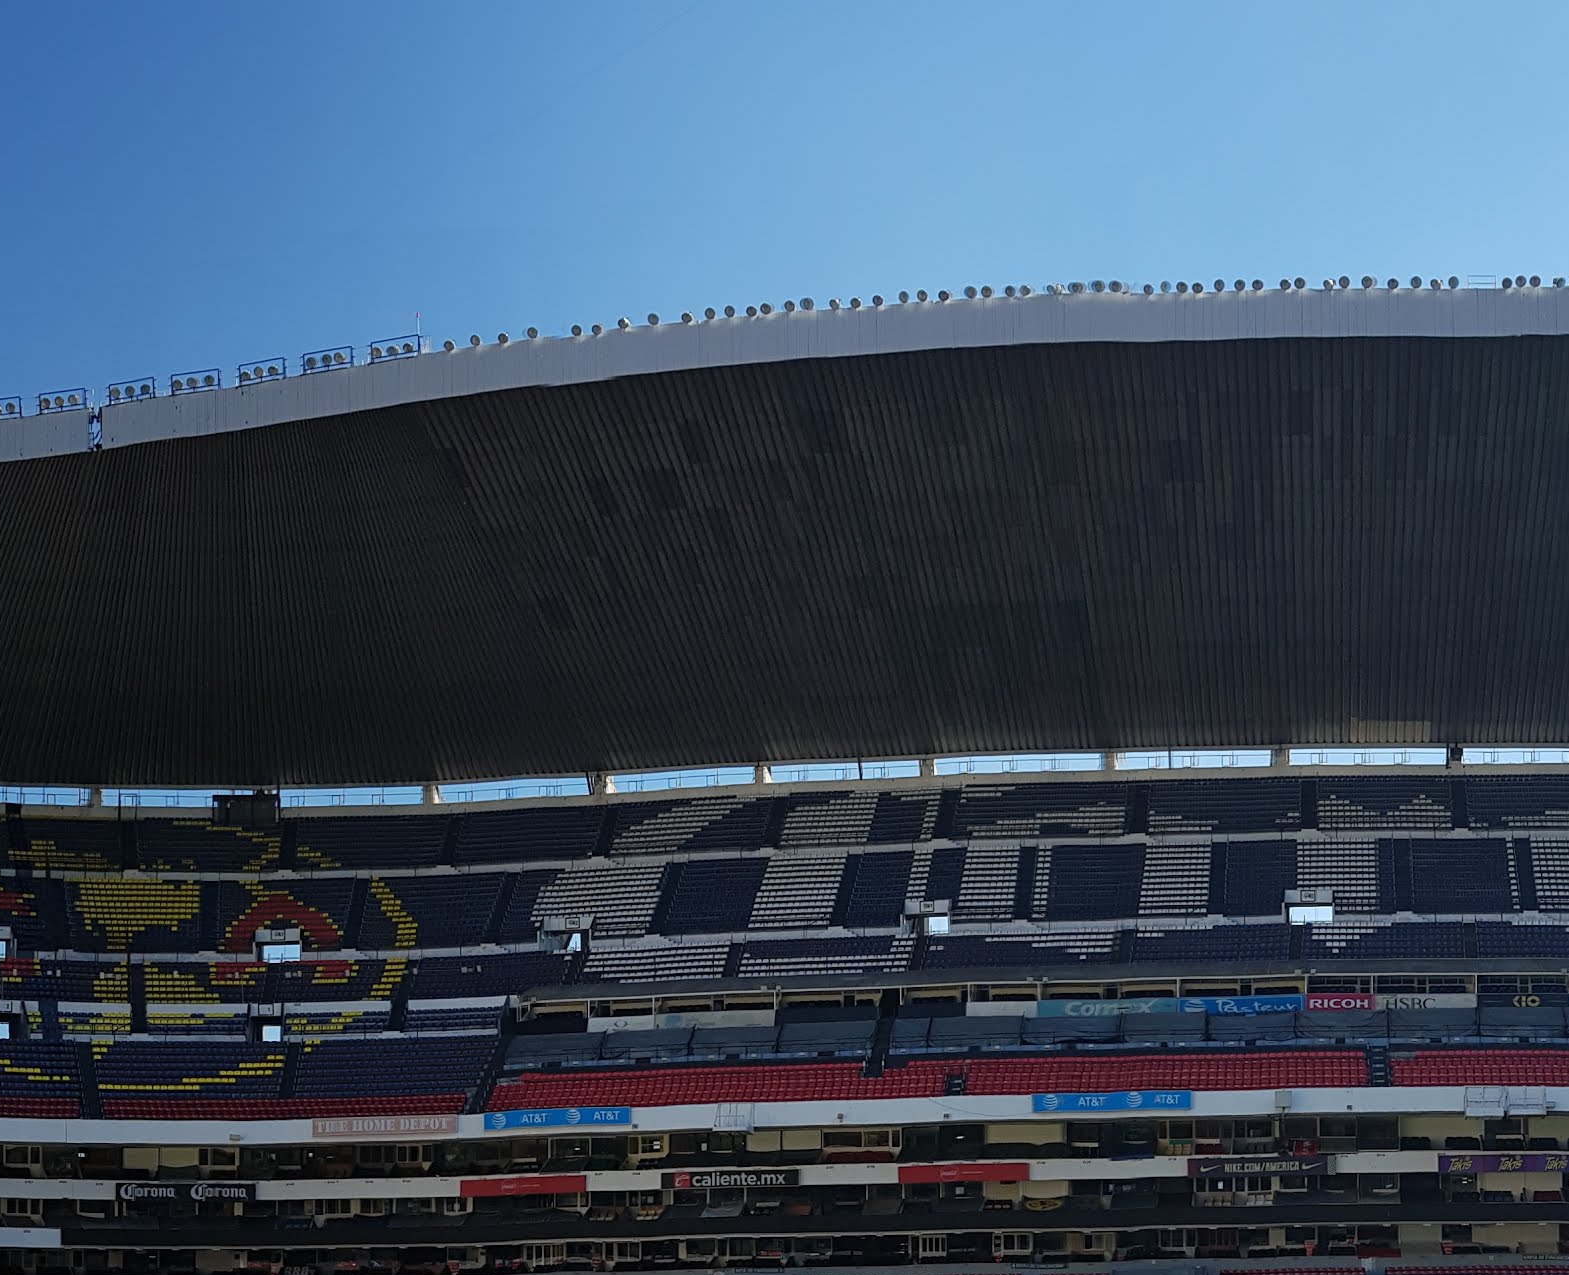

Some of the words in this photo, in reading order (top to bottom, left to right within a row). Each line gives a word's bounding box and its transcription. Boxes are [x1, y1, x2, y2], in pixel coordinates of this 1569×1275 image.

[1309, 998, 1369, 1009] RICOH
[1386, 996, 1436, 1009] HSBC
[1078, 1095, 1104, 1107] AT&T
[1154, 1094, 1180, 1105] AT&T
[522, 1112, 547, 1123] AT&T
[593, 1111, 620, 1122] AT&T
[1224, 1161, 1300, 1173] NIKE.COM/AMERICA
[1448, 1156, 1473, 1172] Takis
[1497, 1156, 1524, 1172] Takis
[1544, 1156, 1569, 1172] Takis
[691, 1171, 786, 1187] caliente.mx
[119, 1183, 176, 1200] Corona
[190, 1183, 247, 1200] Corona
